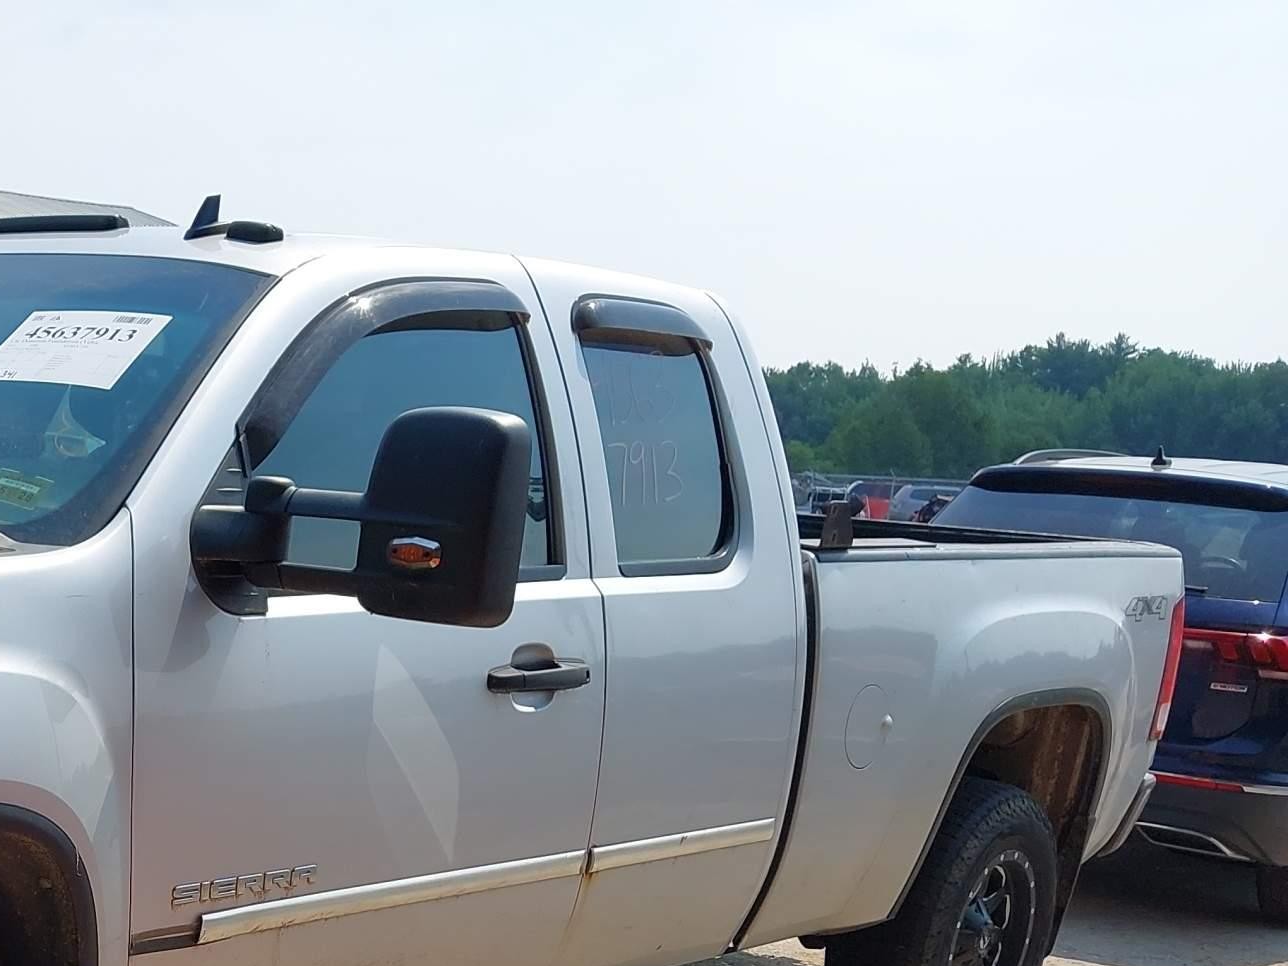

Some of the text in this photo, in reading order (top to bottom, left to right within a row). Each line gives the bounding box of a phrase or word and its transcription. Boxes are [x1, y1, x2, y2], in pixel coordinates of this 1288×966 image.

[24, 326, 138, 343] 45637913
[608, 440, 686, 507] 7913
[171, 864, 318, 907] SIERRA
